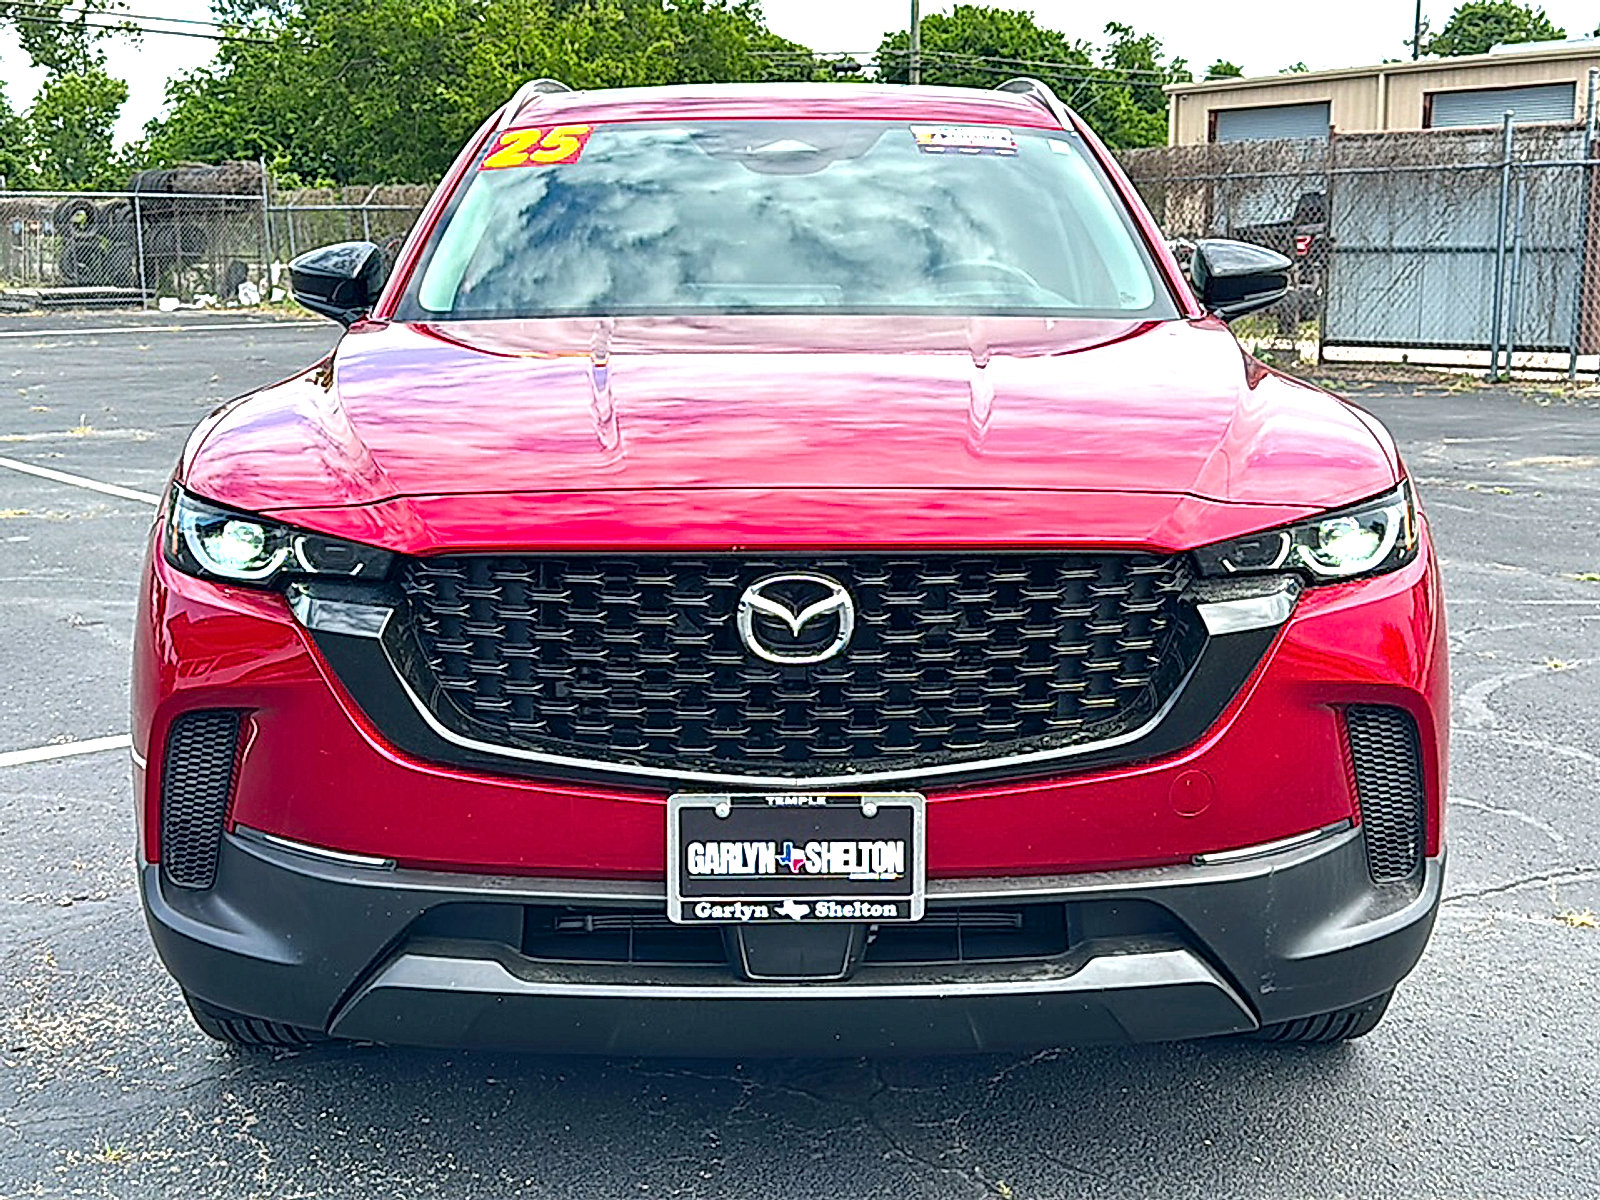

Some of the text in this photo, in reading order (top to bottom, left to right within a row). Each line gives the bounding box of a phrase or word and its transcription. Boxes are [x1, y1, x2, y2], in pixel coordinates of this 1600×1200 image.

[483, 124, 590, 168] 25
[765, 796, 827, 806] TEMPLE
[687, 841, 905, 875] GARLYN SHELTON
[694, 901, 898, 921] Garlyn Shelton
